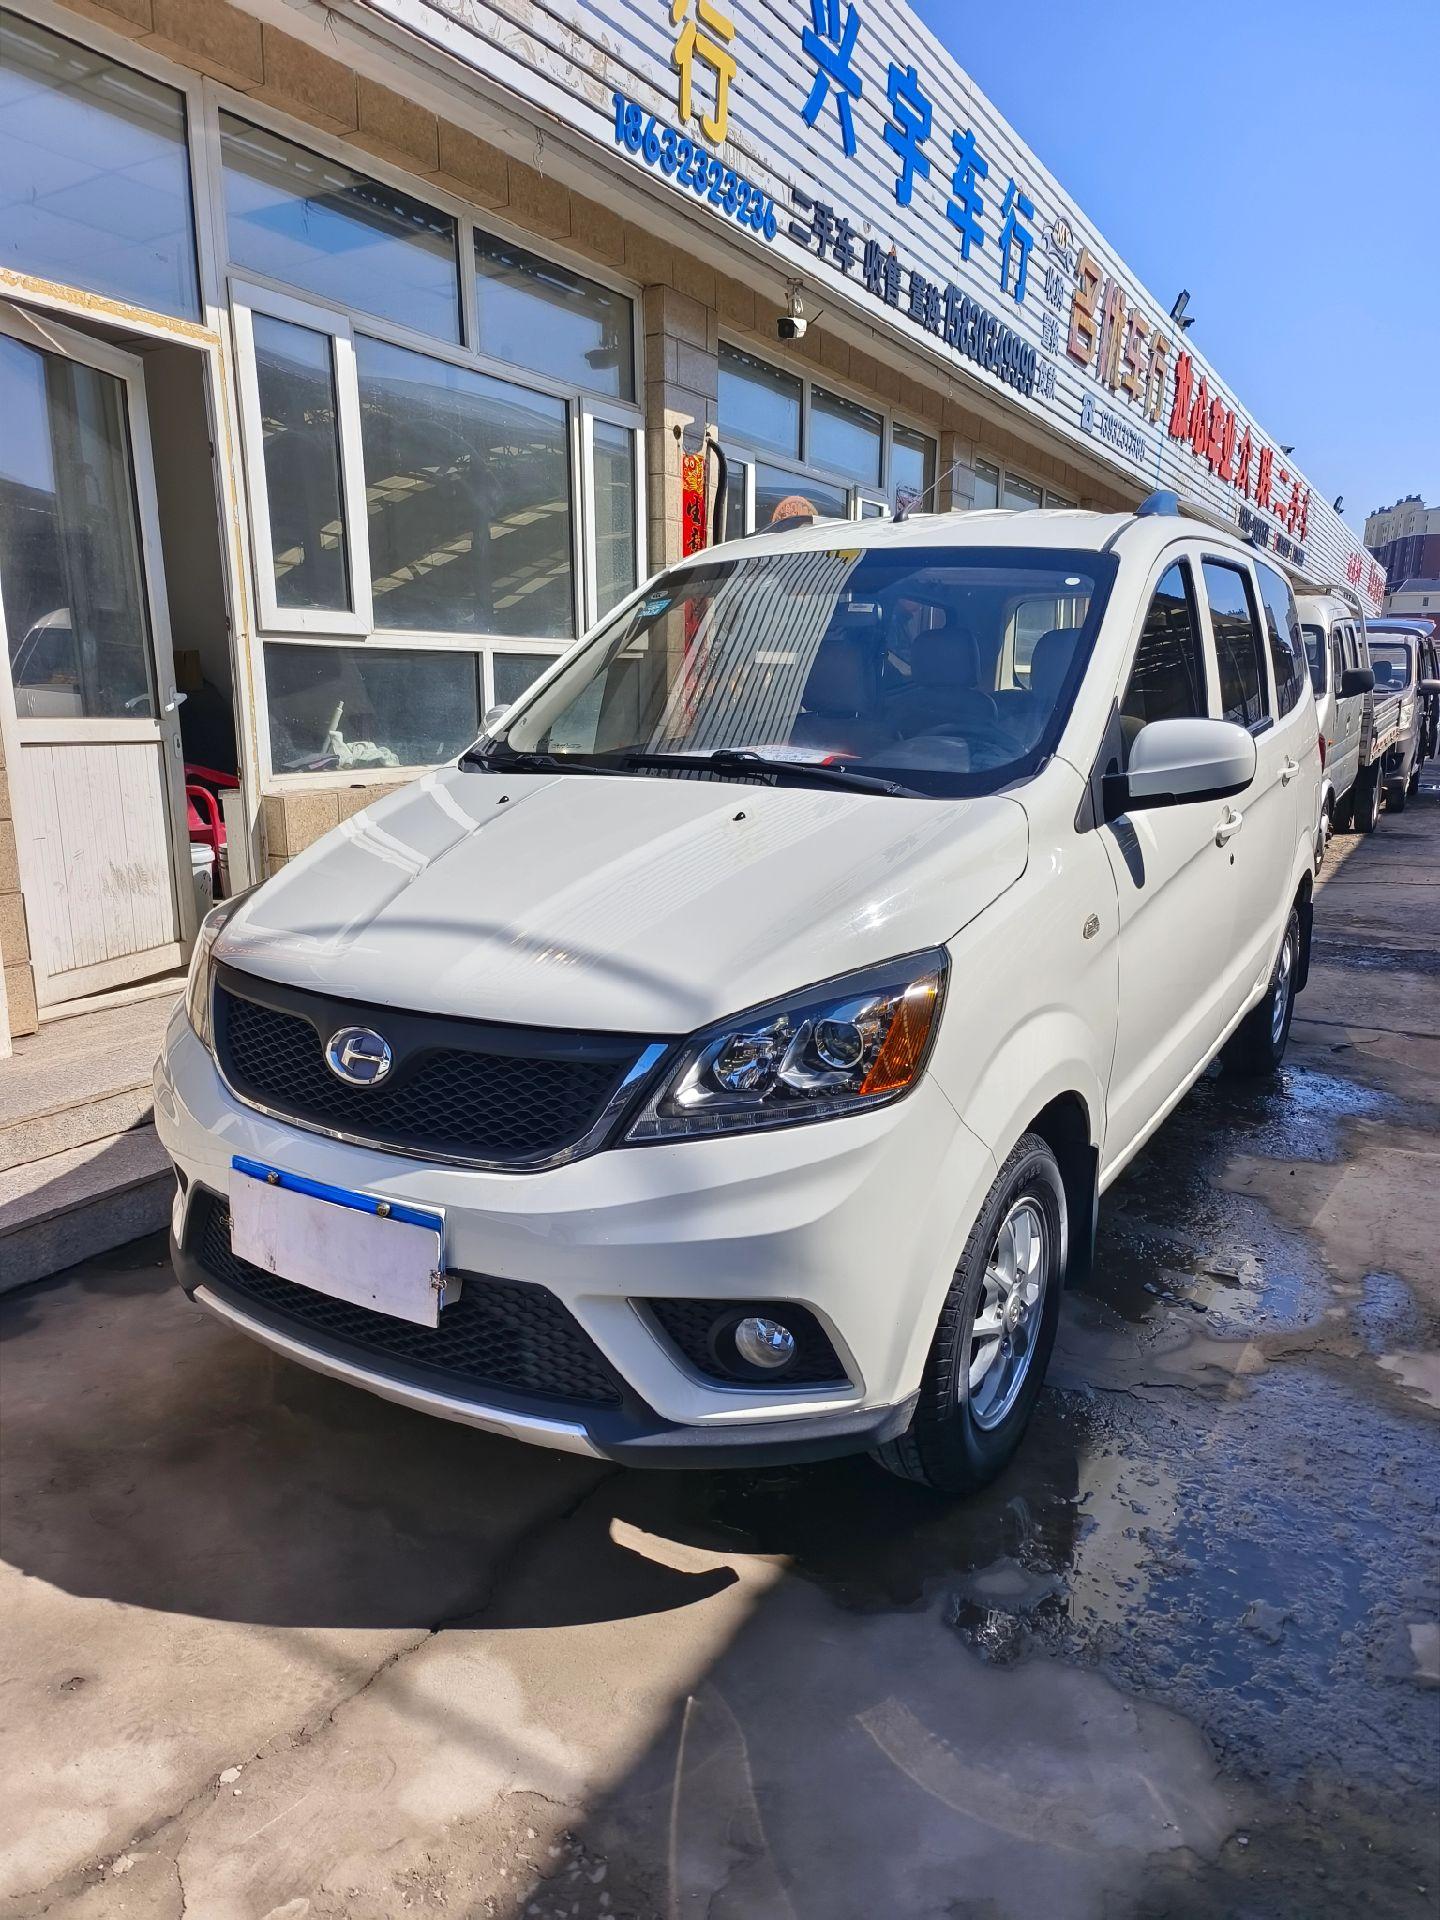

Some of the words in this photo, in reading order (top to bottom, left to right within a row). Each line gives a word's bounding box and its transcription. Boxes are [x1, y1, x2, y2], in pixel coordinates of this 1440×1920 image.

[669, 0, 738, 147] 行
[612, 93, 778, 242] 18632323236
[788, 187, 858, 276] 二手车
[908, 270, 942, 337] 置换
[942, 282, 1037, 399] 15830349999
[1040, 312, 1060, 356] 置换
